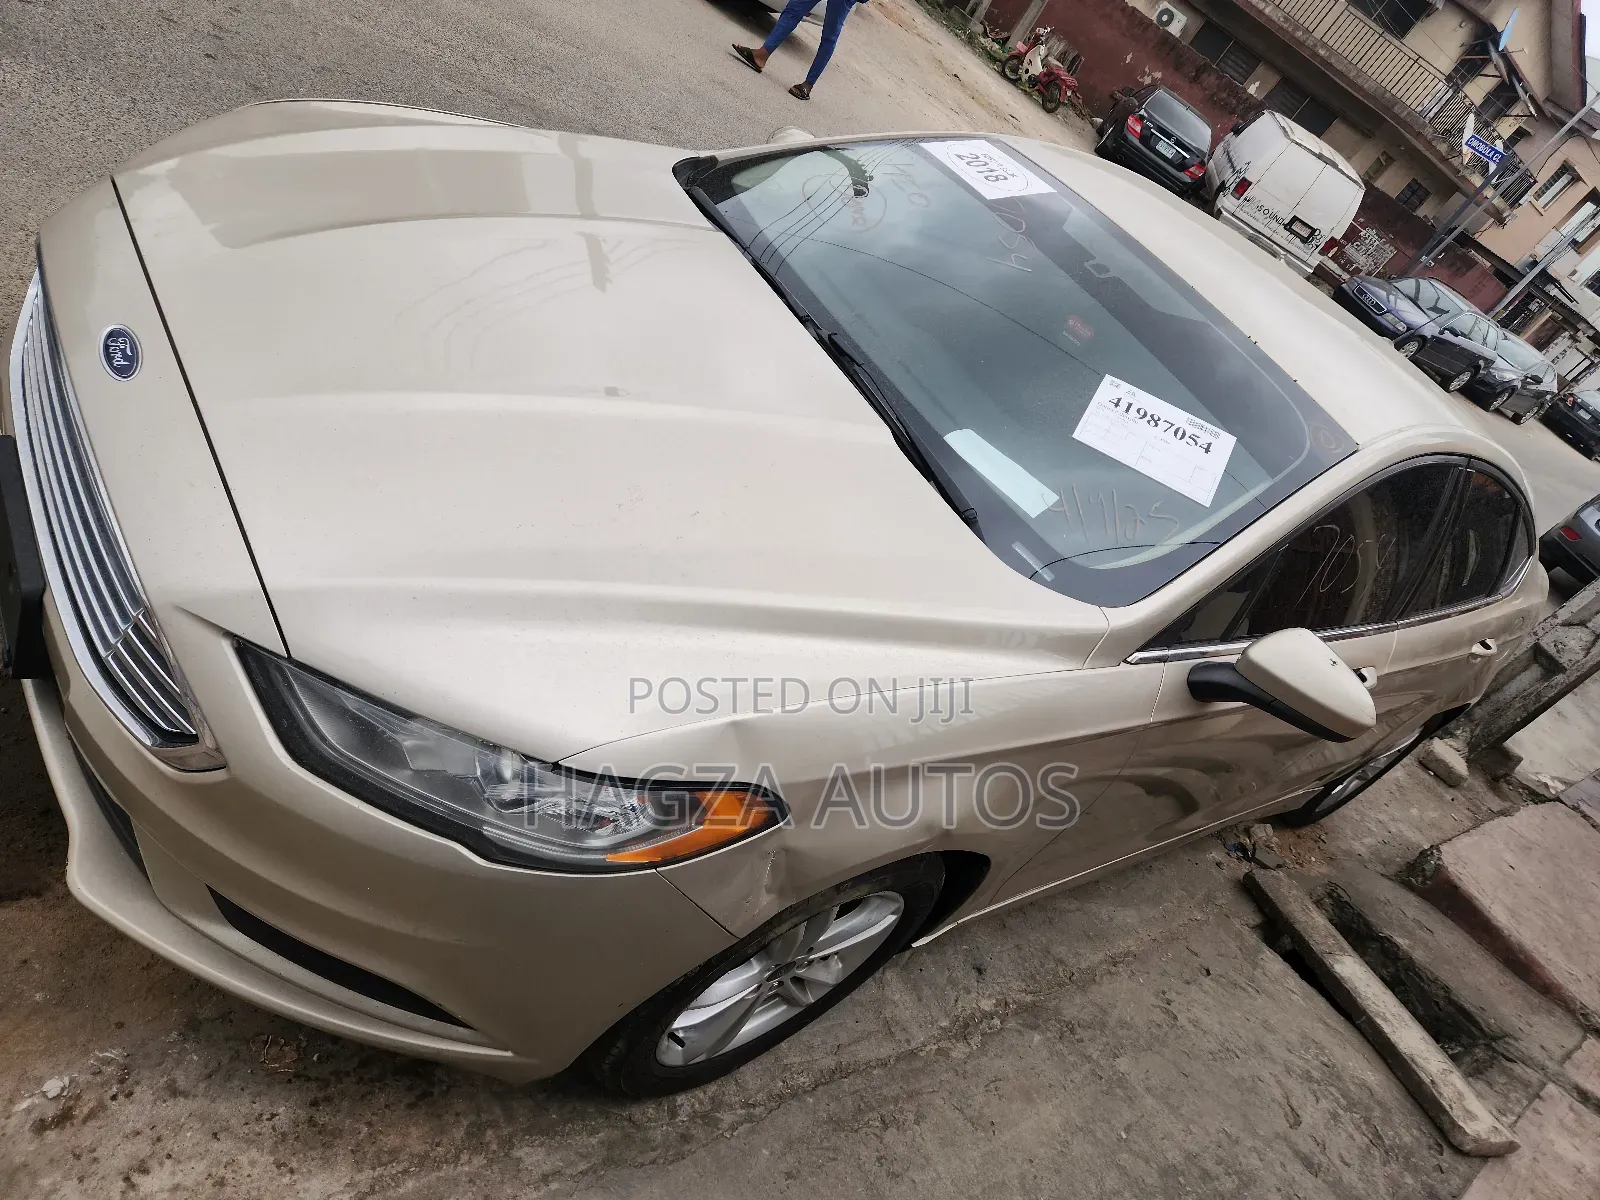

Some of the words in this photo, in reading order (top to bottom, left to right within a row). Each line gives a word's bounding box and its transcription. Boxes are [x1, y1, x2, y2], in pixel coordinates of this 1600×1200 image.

[954, 153, 1008, 182] 2018
[107, 337, 132, 367] Ford
[1109, 397, 1213, 454] 41987054
